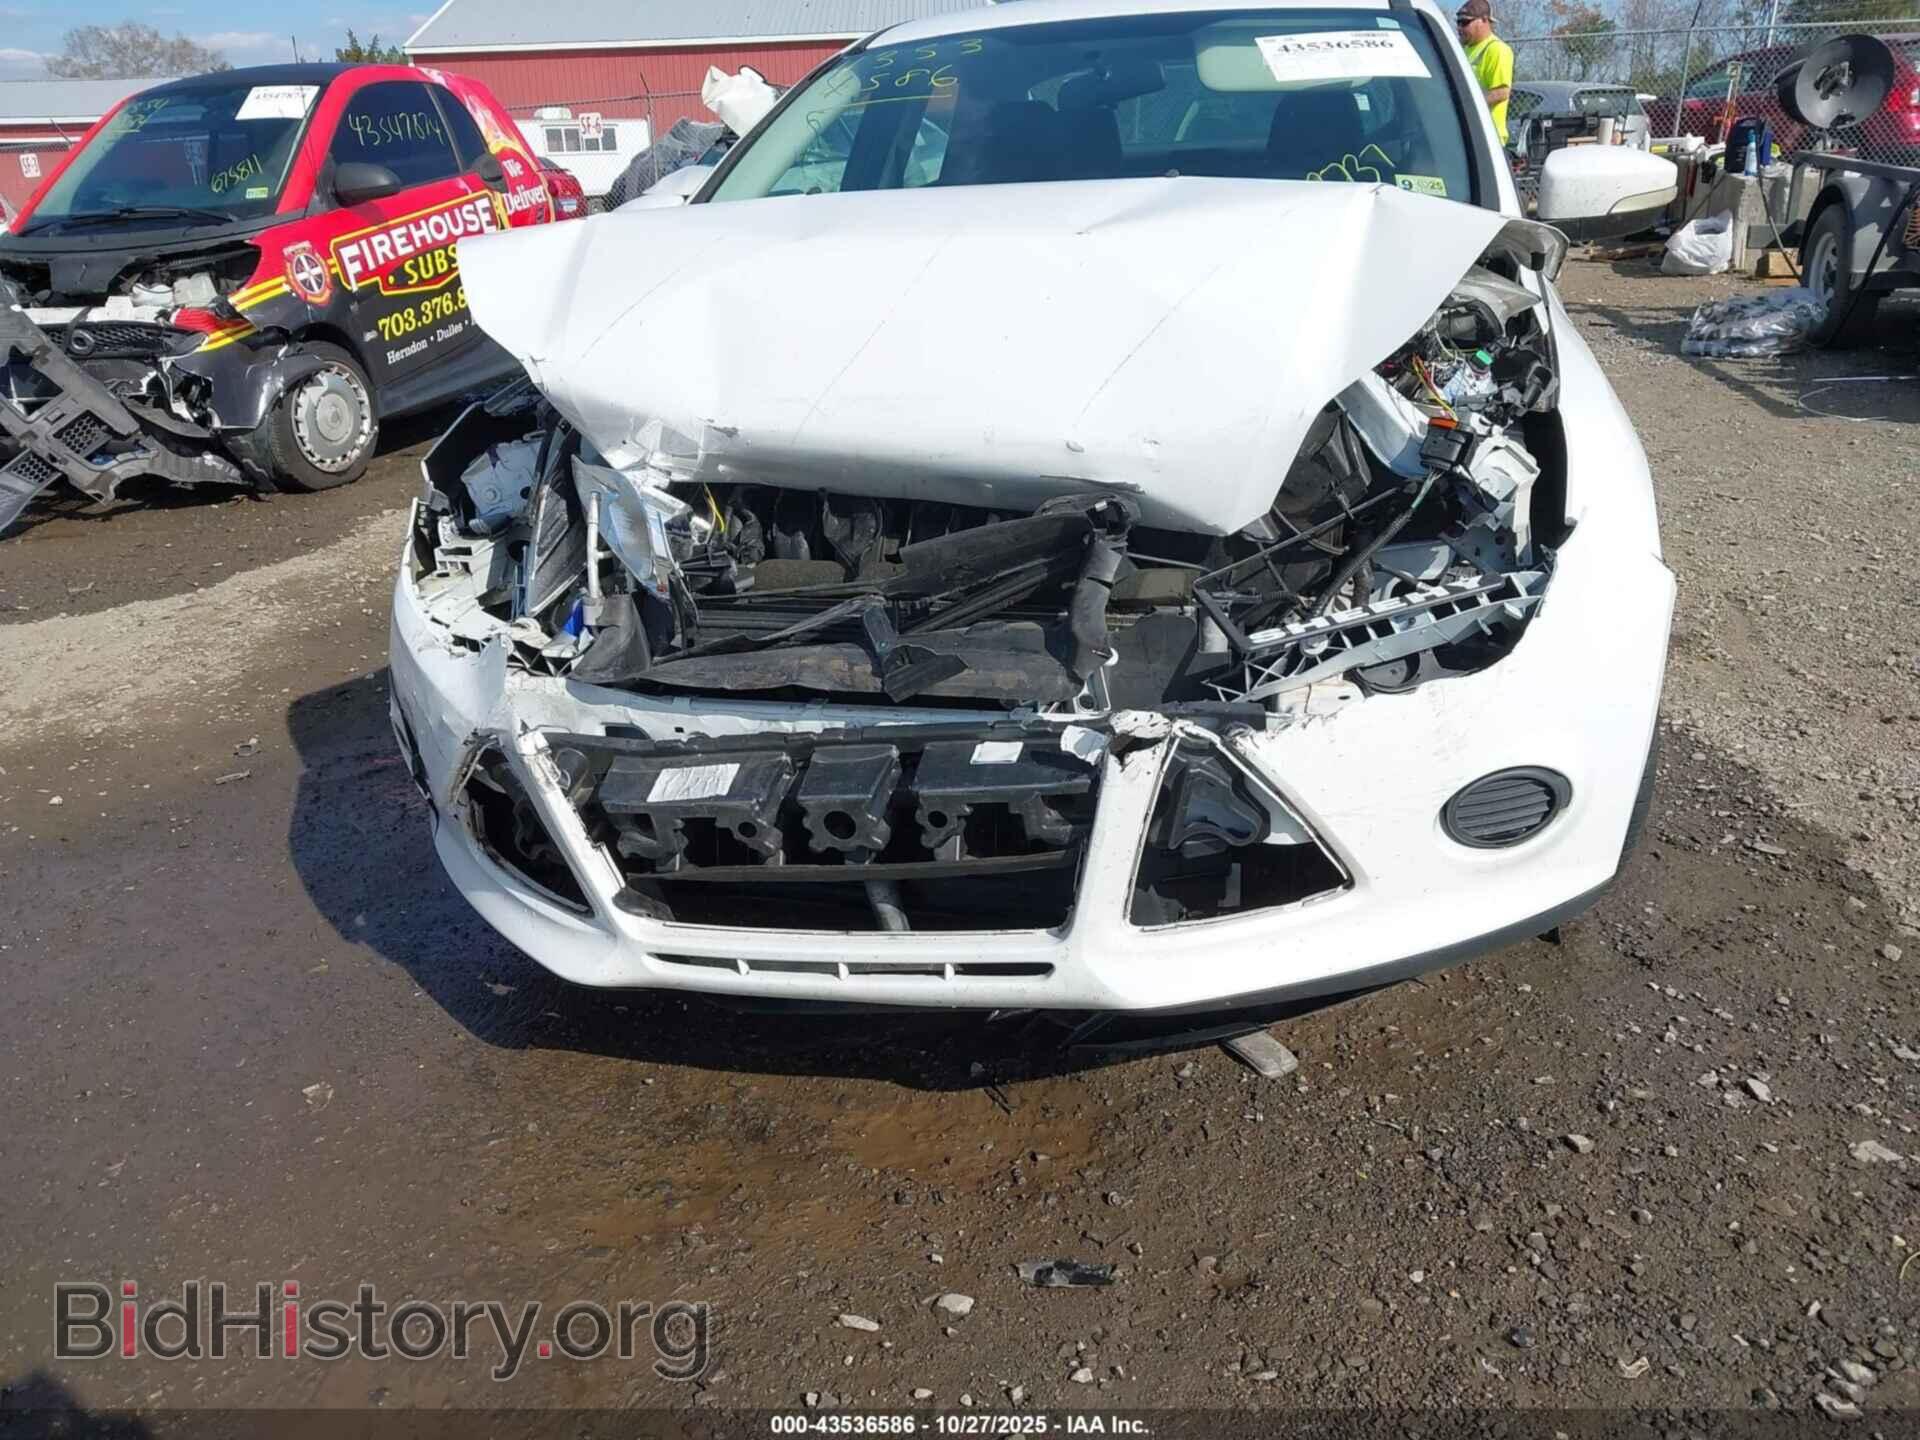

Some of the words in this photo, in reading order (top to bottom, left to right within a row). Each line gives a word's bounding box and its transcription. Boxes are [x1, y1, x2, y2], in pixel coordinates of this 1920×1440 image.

[1277, 39, 1394, 54] 43536586
[502, 158, 524, 178] We
[503, 183, 546, 216] Deliver
[338, 197, 498, 293] FIREHOUSE
[403, 243, 458, 285] SUBS
[386, 339, 428, 365] Herndon
[436, 322, 463, 342] Dulles
